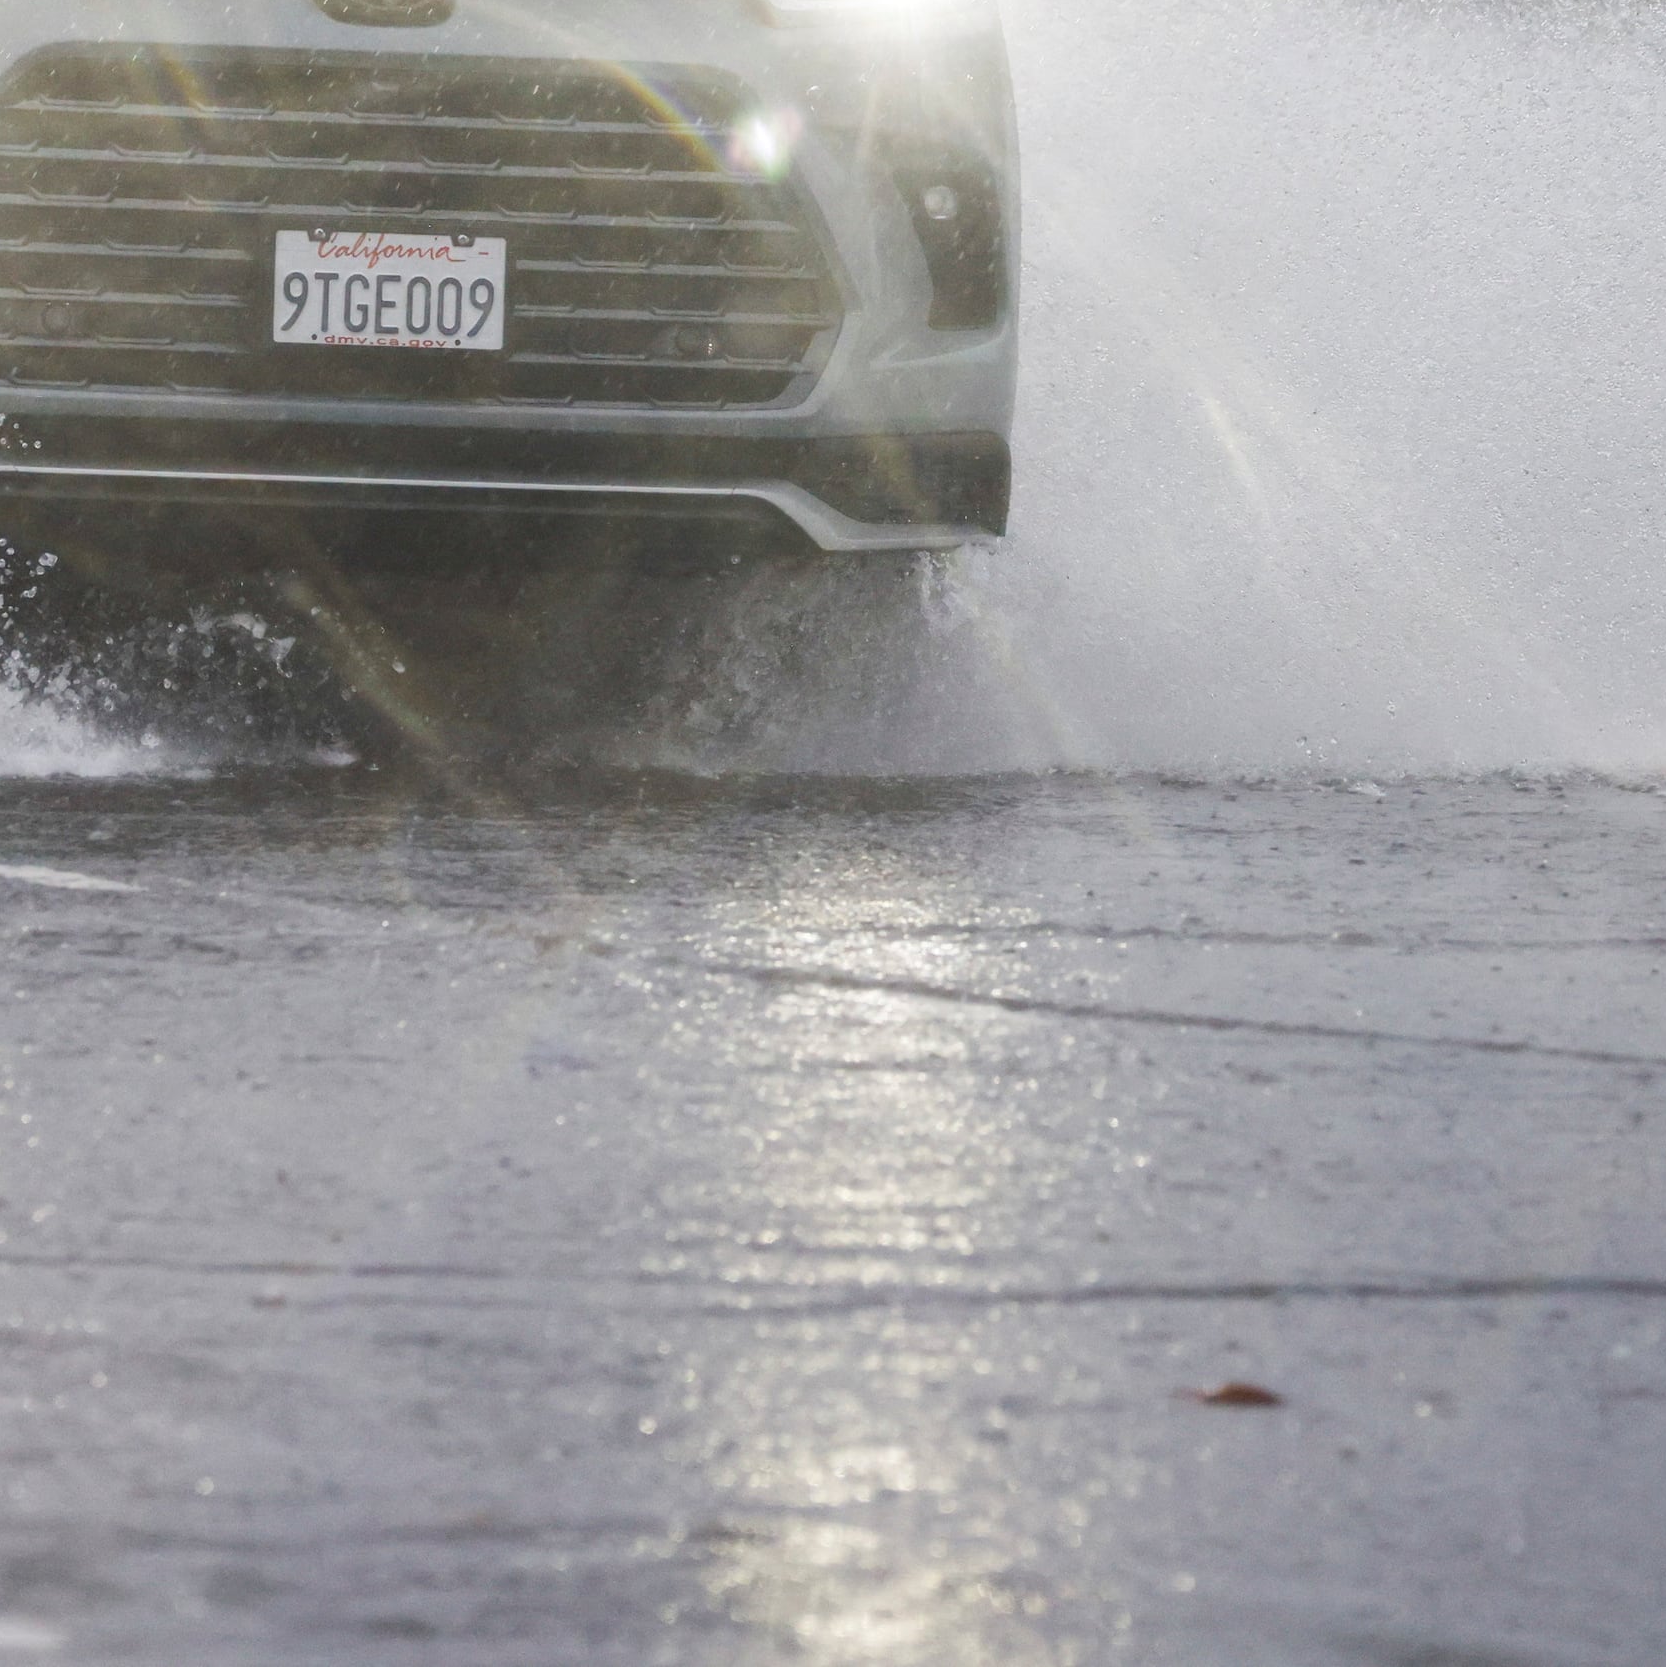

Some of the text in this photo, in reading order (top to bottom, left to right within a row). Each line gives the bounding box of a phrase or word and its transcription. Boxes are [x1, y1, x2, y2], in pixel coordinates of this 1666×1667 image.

[316, 233, 467, 268] California
[281, 271, 496, 338] 9TGE009
[324, 334, 447, 349] dmv.ca.gov
